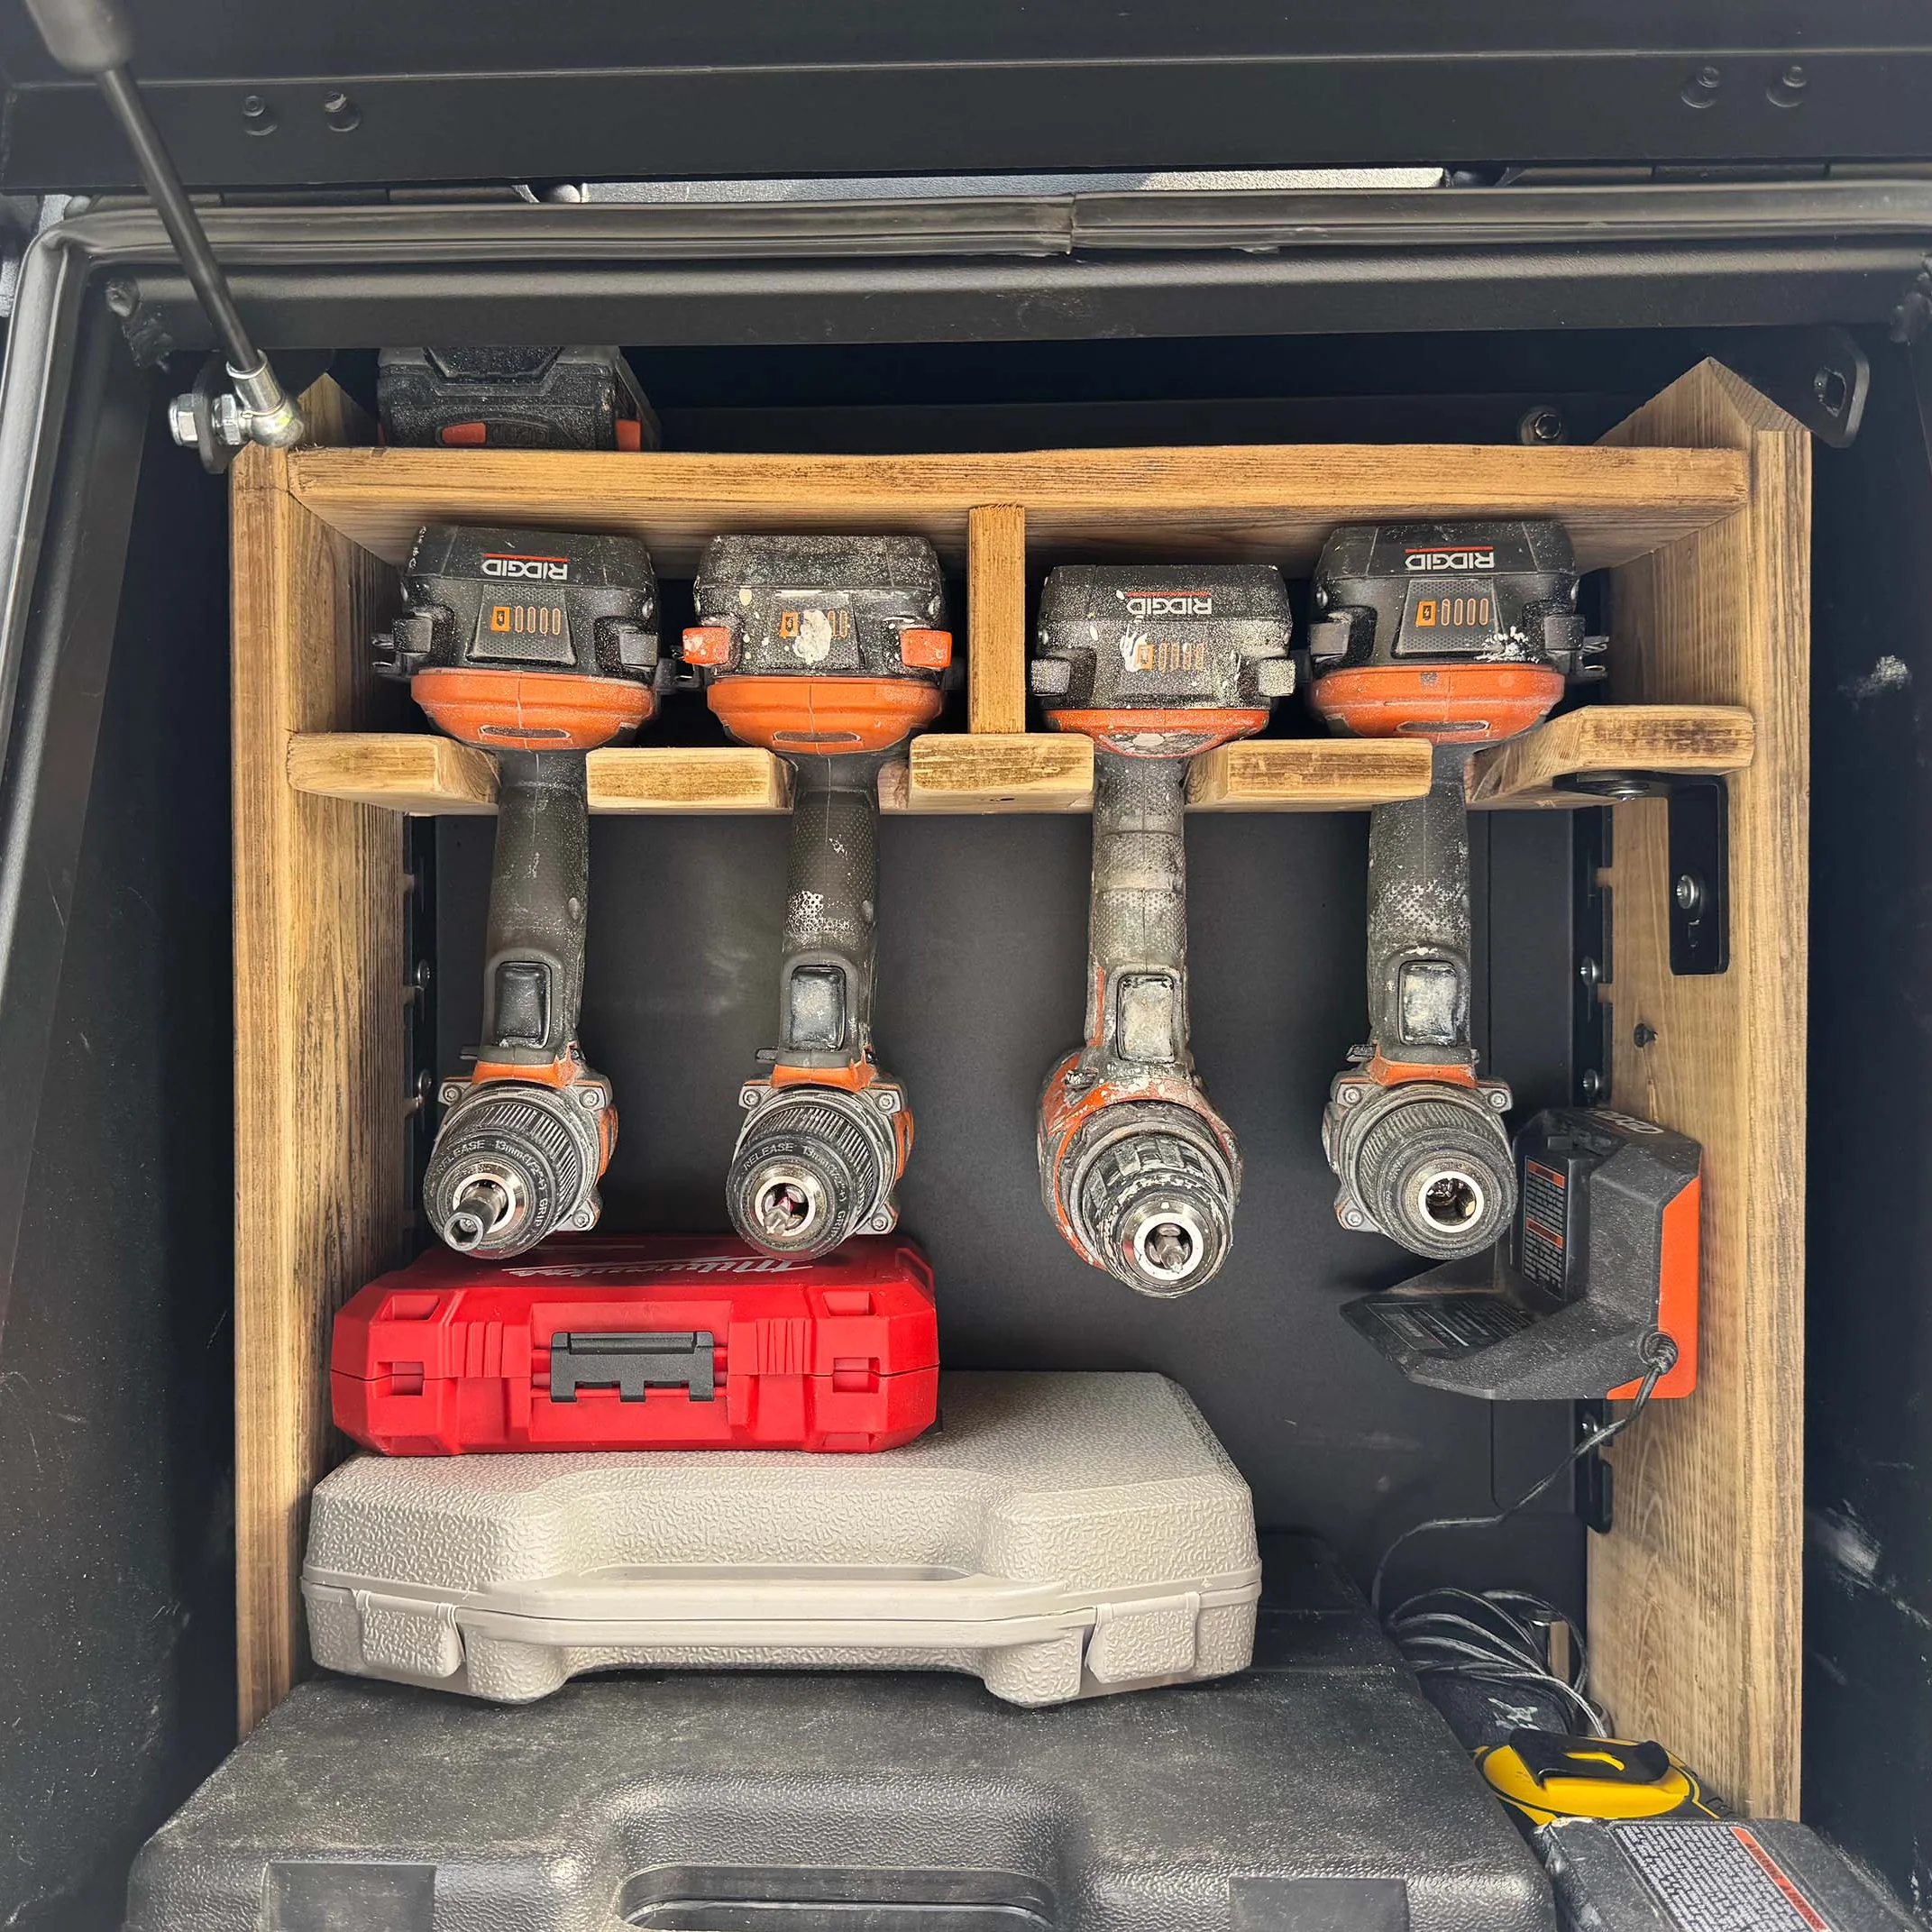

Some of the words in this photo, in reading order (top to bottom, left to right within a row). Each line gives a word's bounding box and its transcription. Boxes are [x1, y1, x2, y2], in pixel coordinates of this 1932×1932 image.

[481, 559, 568, 581] RIDGID
[1404, 552, 1495, 571] RIDGID
[1126, 598, 1213, 615] RIDGID
